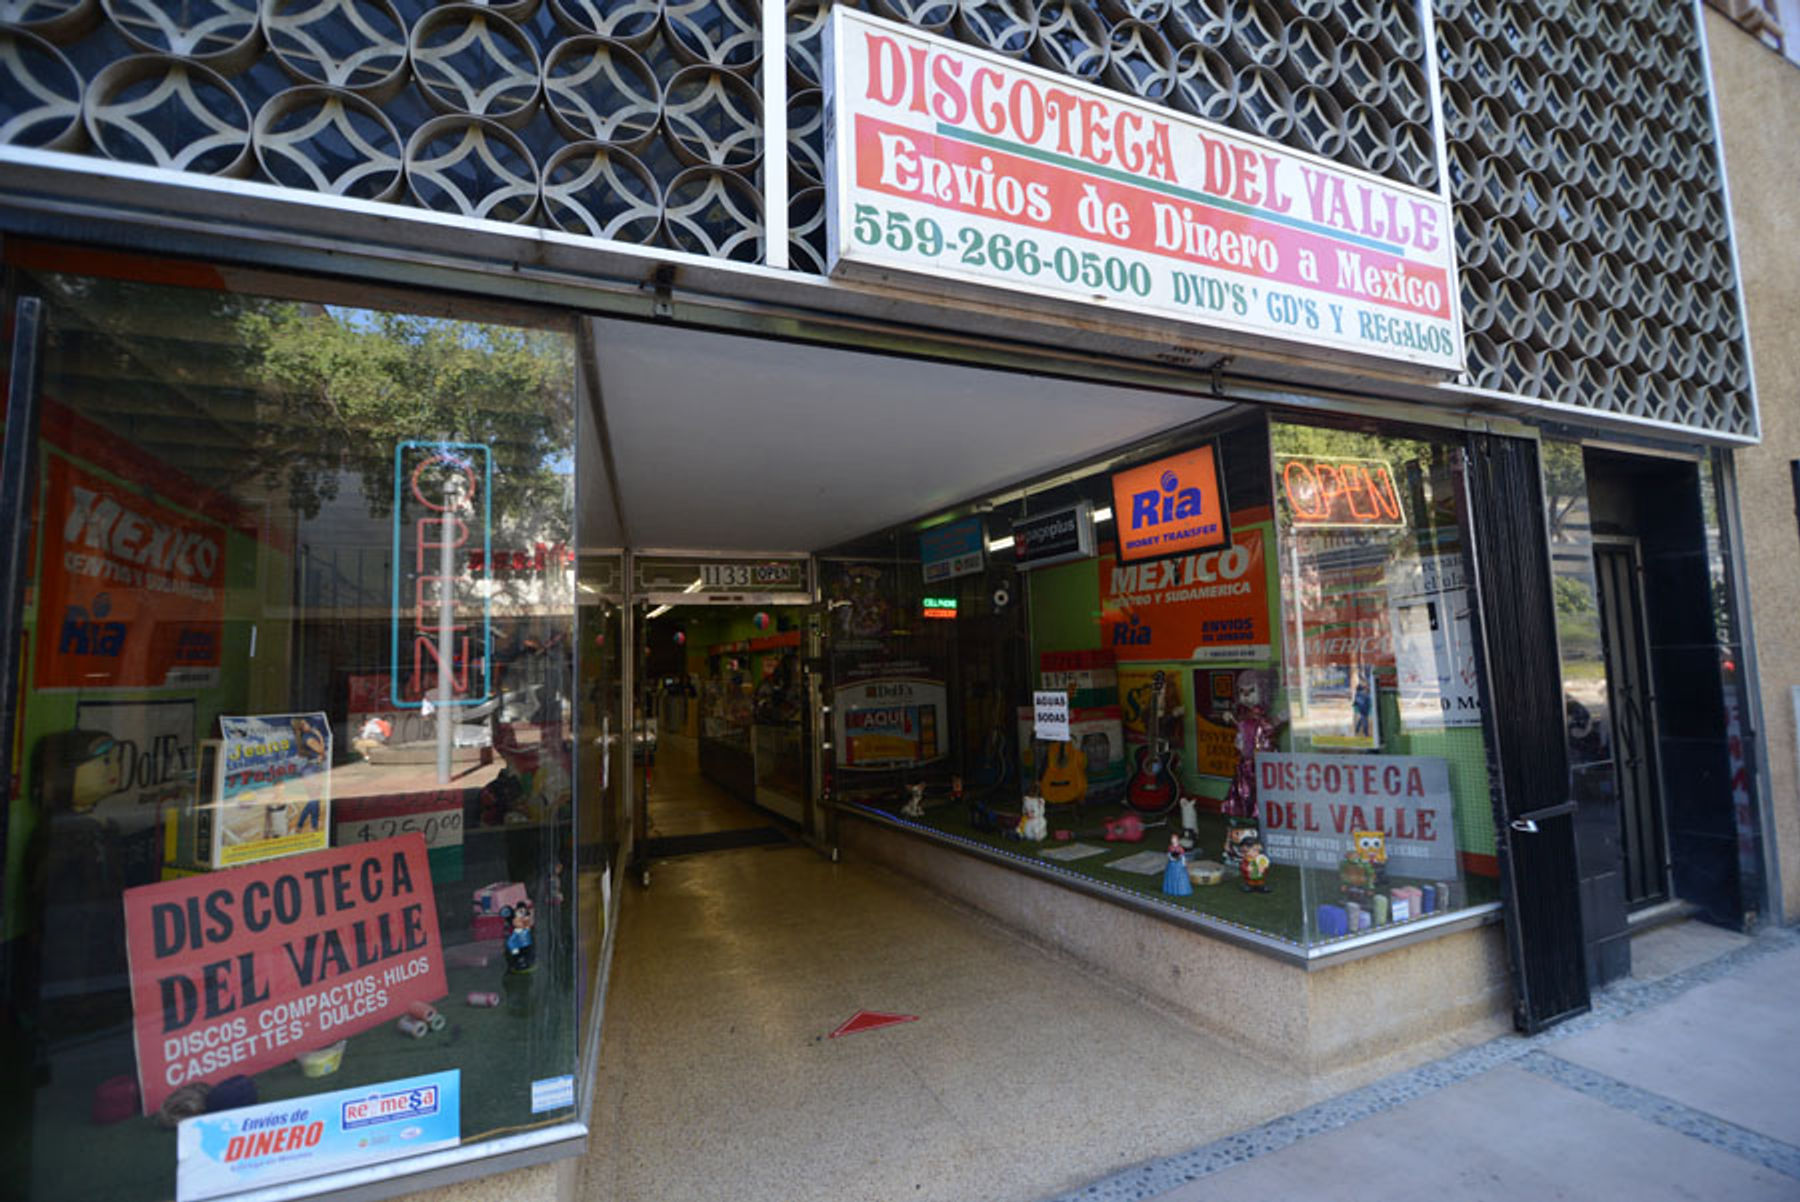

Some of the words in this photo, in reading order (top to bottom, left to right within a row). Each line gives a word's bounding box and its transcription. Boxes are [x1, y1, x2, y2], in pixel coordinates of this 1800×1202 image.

[864, 31, 1179, 183] DISCOTECA
[1197, 133, 1292, 214] DEL
[1300, 166, 1440, 252] VALLE
[877, 130, 1052, 222] Envios
[1078, 182, 1131, 240] de
[1151, 201, 1279, 273] Dinero
[1298, 247, 1319, 283] a
[1337, 246, 1442, 312] Mexico
[854, 203, 1152, 297] 559-266-0500
[1328, 303, 1344, 335] Y
[1357, 309, 1454, 356] REGALOS
[1131, 470, 1203, 530] Ria
[1284, 461, 1400, 519] OPEN
[63, 485, 219, 581] MEXICO
[1163, 523, 1218, 541] TRANSFER
[410, 454, 477, 694] OPEN
[703, 566, 750, 585] 1133
[1109, 544, 1250, 595] MEXICO
[1111, 612, 1152, 646] Ria
[1037, 711, 1066, 724] SODAS
[1261, 761, 1425, 797] DISCOTECA
[1265, 801, 1320, 832] DEL
[1328, 803, 1438, 841] VALLE
[152, 851, 414, 959] DISCOTECA
[156, 952, 270, 1035] DEL
[283, 903, 428, 988] VALLE
[319, 989, 388, 1031] DULCES
[163, 1017, 248, 1062] DISCOS
[290, 1108, 310, 1123] de
[224, 1120, 325, 1164] DINERO
